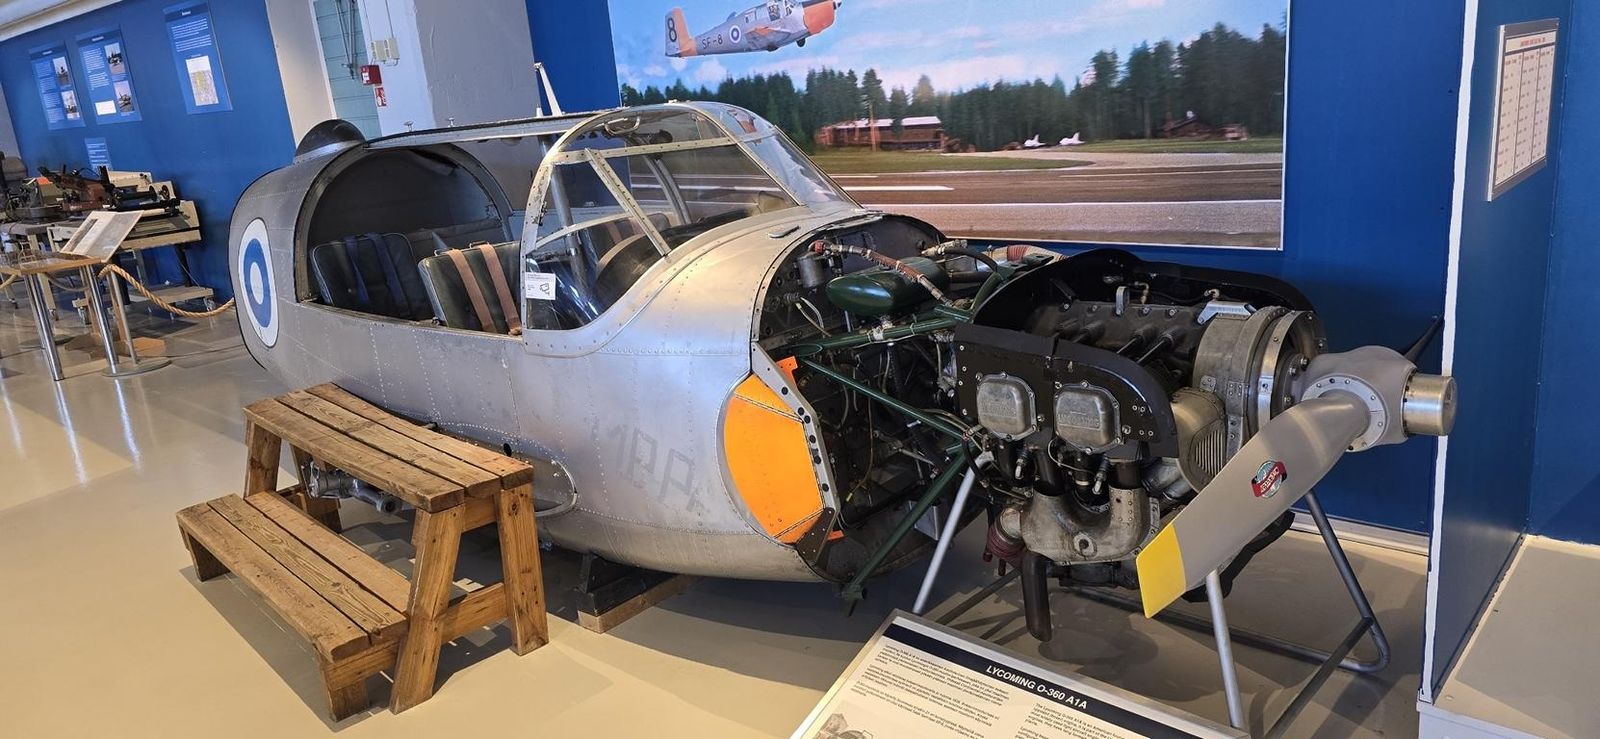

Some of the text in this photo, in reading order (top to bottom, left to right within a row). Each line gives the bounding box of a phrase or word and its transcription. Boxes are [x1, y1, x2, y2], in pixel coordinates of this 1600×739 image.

[667, 17, 677, 42] 8
[701, 34, 723, 49] SF-8
[986, 665, 1087, 709] LYCOMING O-360 A1A
